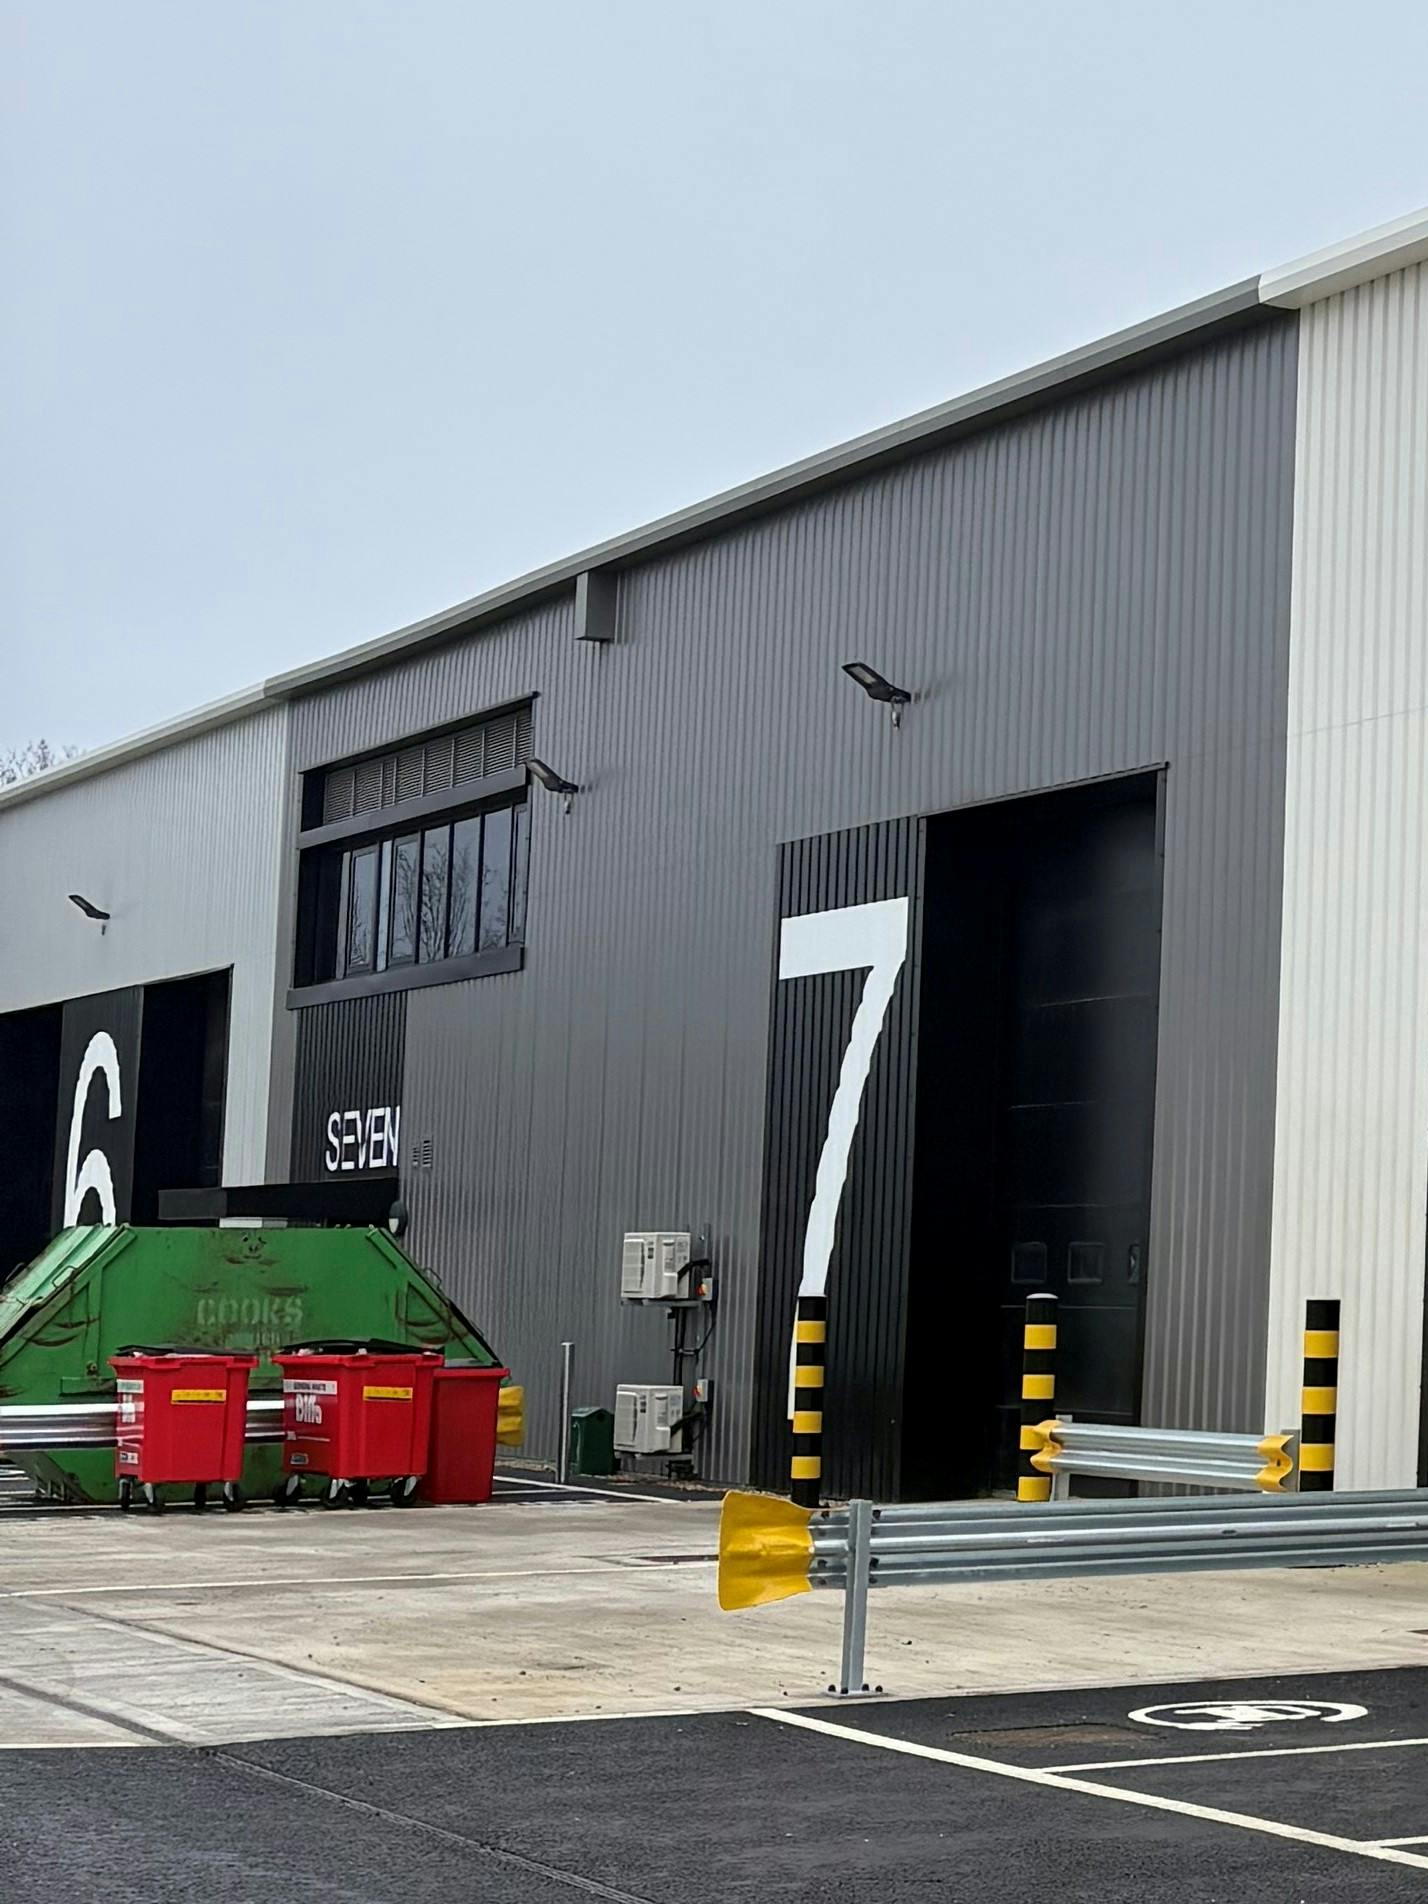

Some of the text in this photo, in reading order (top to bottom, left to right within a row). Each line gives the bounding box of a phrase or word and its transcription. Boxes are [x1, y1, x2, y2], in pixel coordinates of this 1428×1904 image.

[64, 1031, 121, 1227] 6
[325, 1105, 400, 1172] SEVEN
[779, 896, 908, 1420] 7
